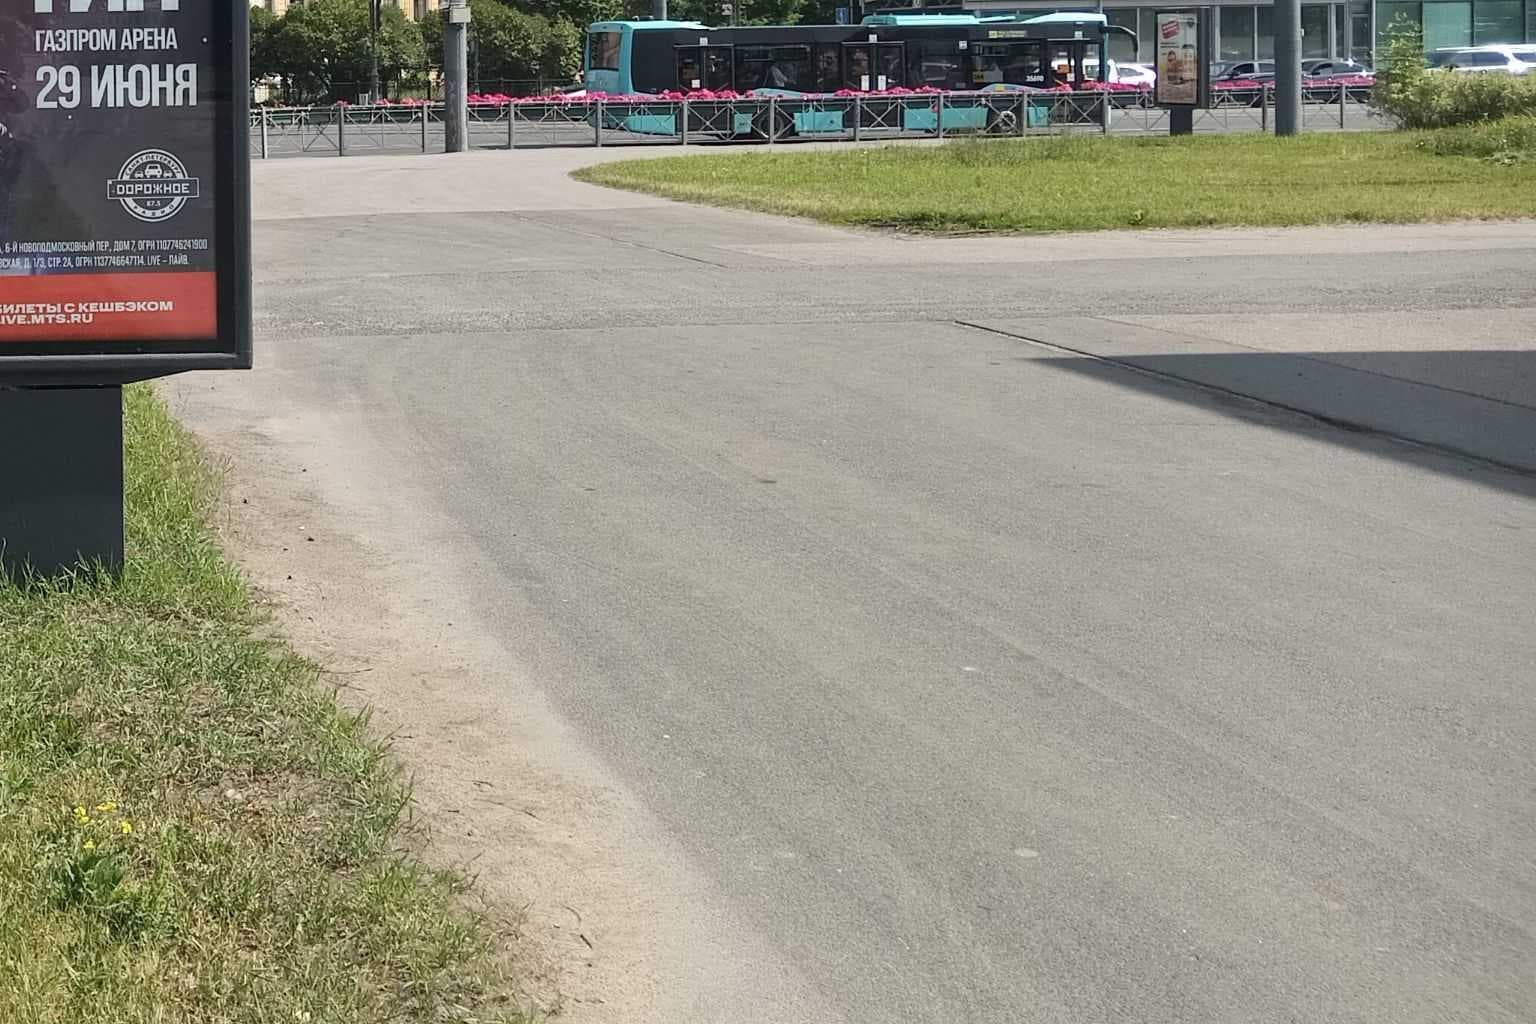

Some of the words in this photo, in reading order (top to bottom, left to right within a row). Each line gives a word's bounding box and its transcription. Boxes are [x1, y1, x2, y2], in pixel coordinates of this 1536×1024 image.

[35, 28, 117, 53] ГАЗПРОМ
[120, 27, 178, 51] АРЕНА
[36, 64, 81, 110] 29
[91, 62, 198, 109] ИЮНЯ
[64, 303, 76, 314] С
[79, 301, 173, 314] КЕШБЭКОМ
